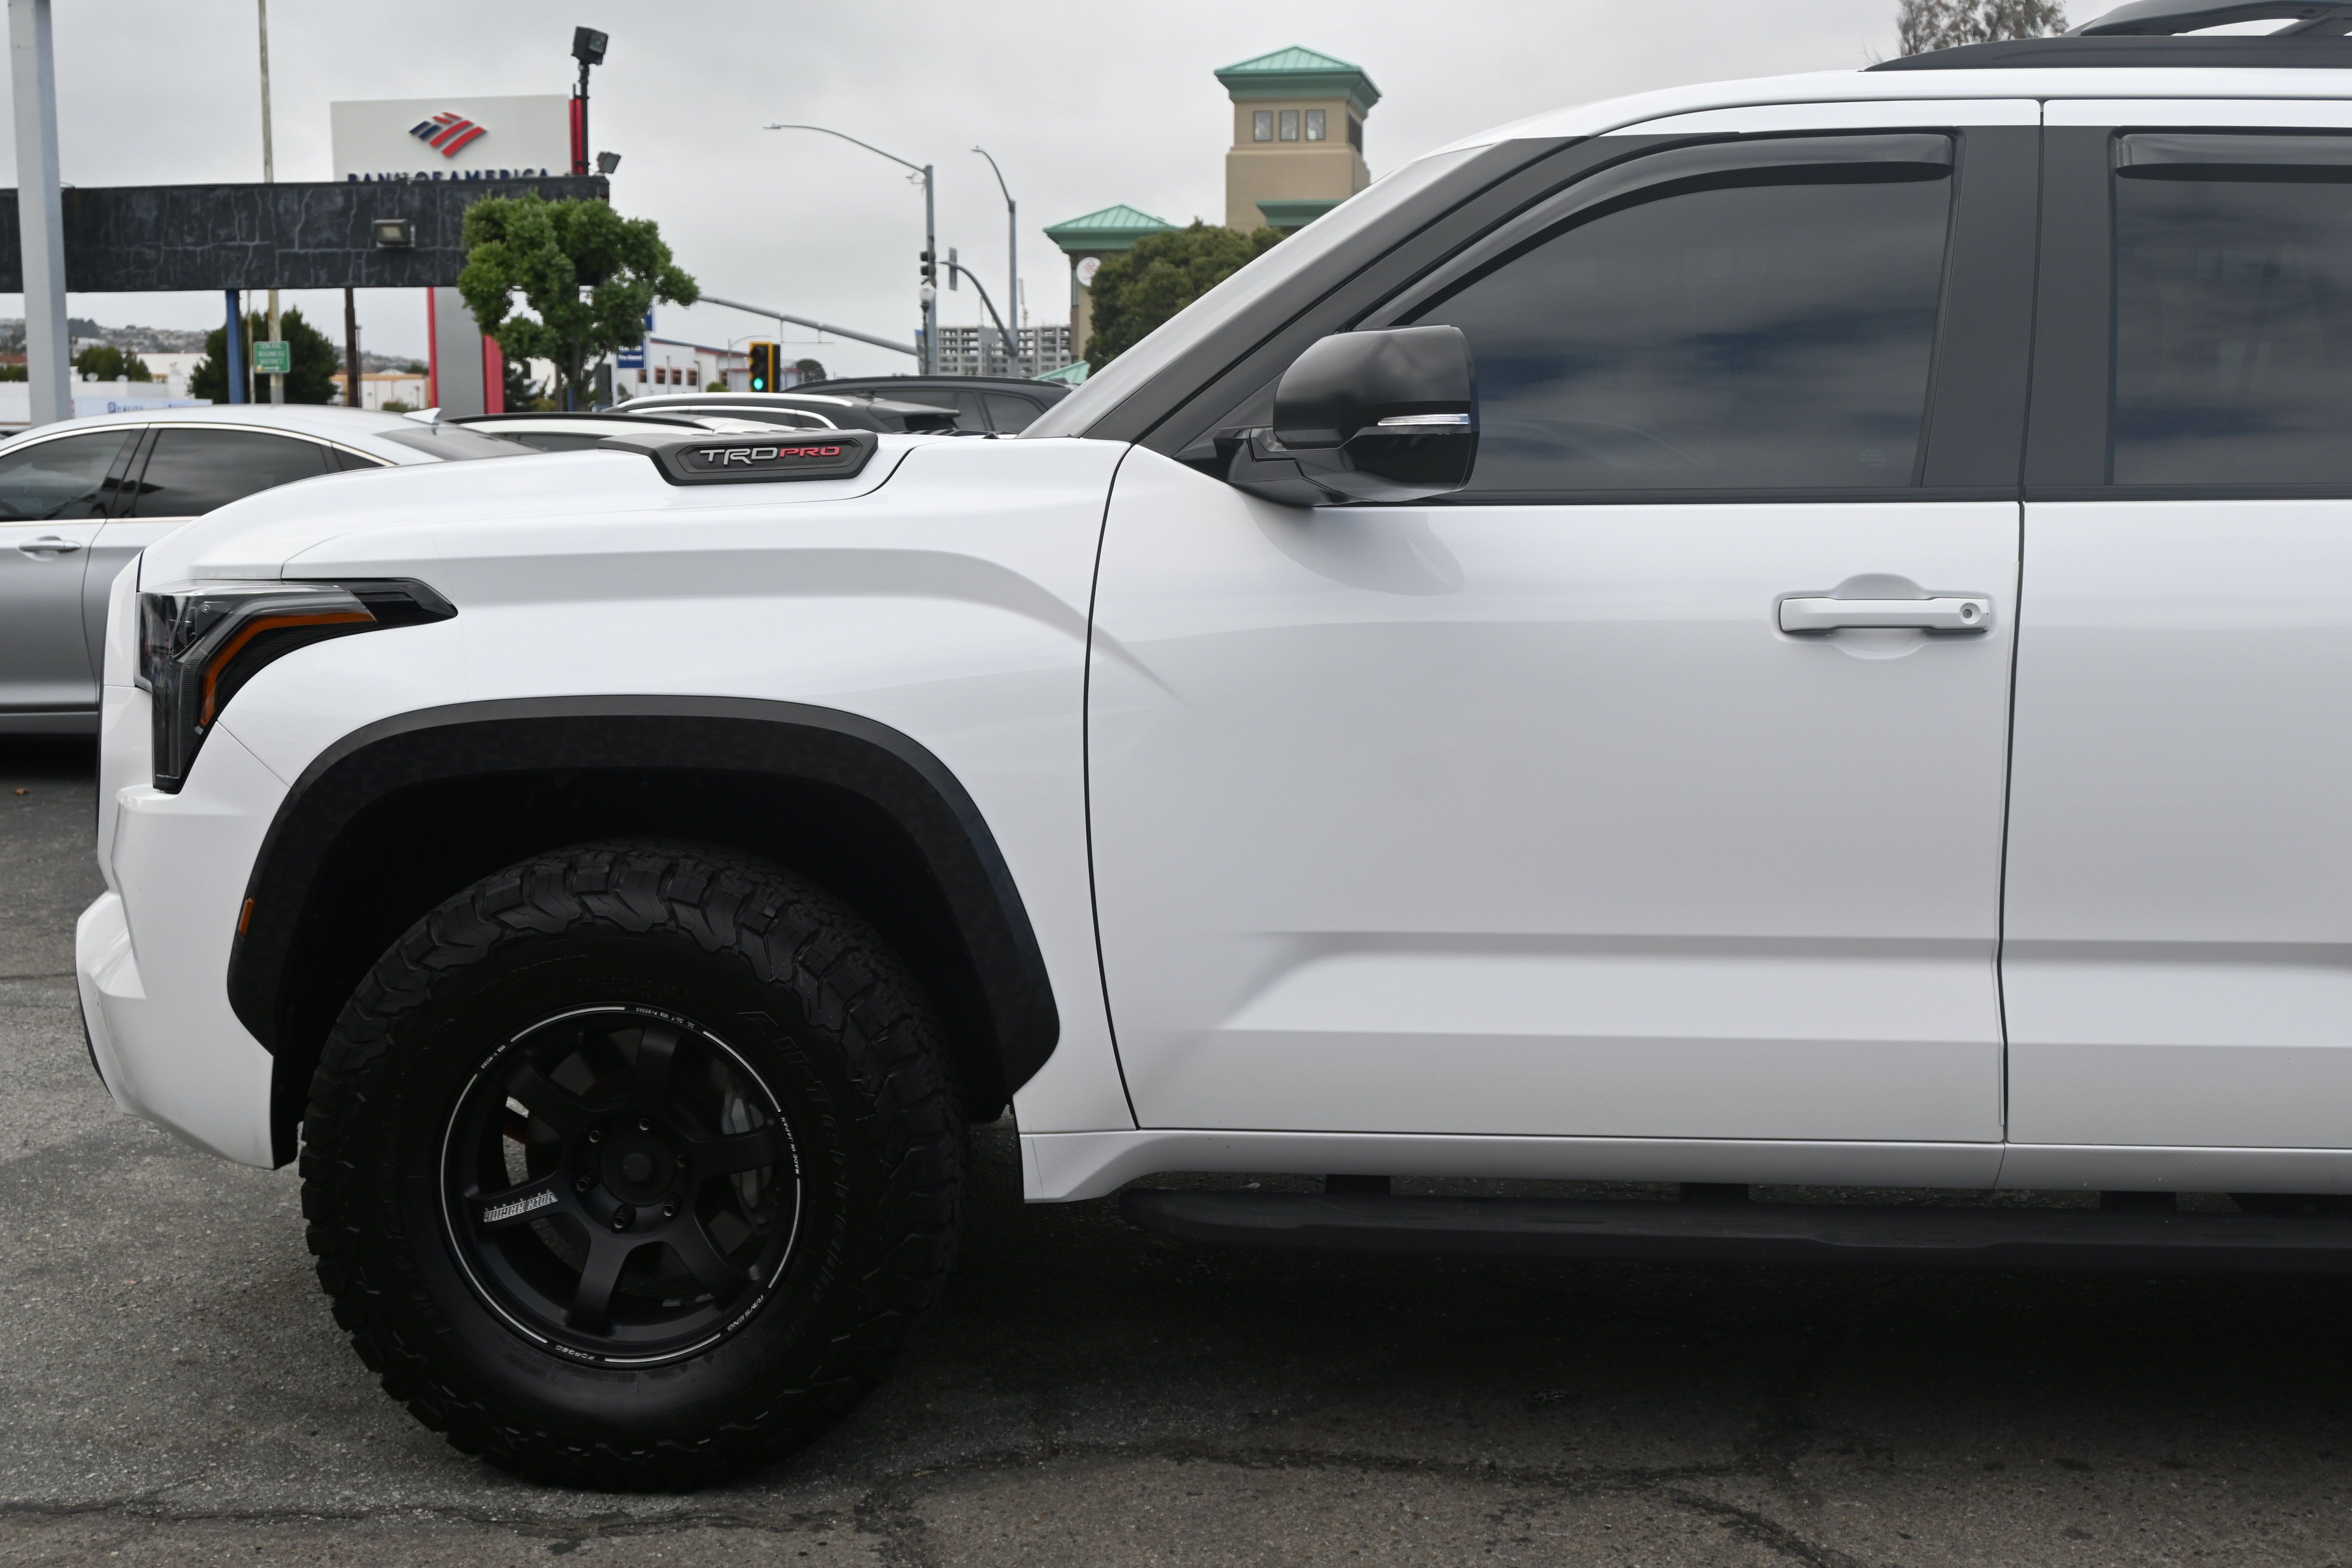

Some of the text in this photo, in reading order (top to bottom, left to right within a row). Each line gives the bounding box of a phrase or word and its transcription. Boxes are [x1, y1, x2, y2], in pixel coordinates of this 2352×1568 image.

[348, 172, 408, 182] BAN
[700, 446, 841, 467] TRD PRO
[780, 1117, 792, 1142] JAPAN
[484, 1200, 525, 1222] RACING
[743, 1294, 764, 1318] RAYS
[555, 1344, 595, 1360] FORGED
